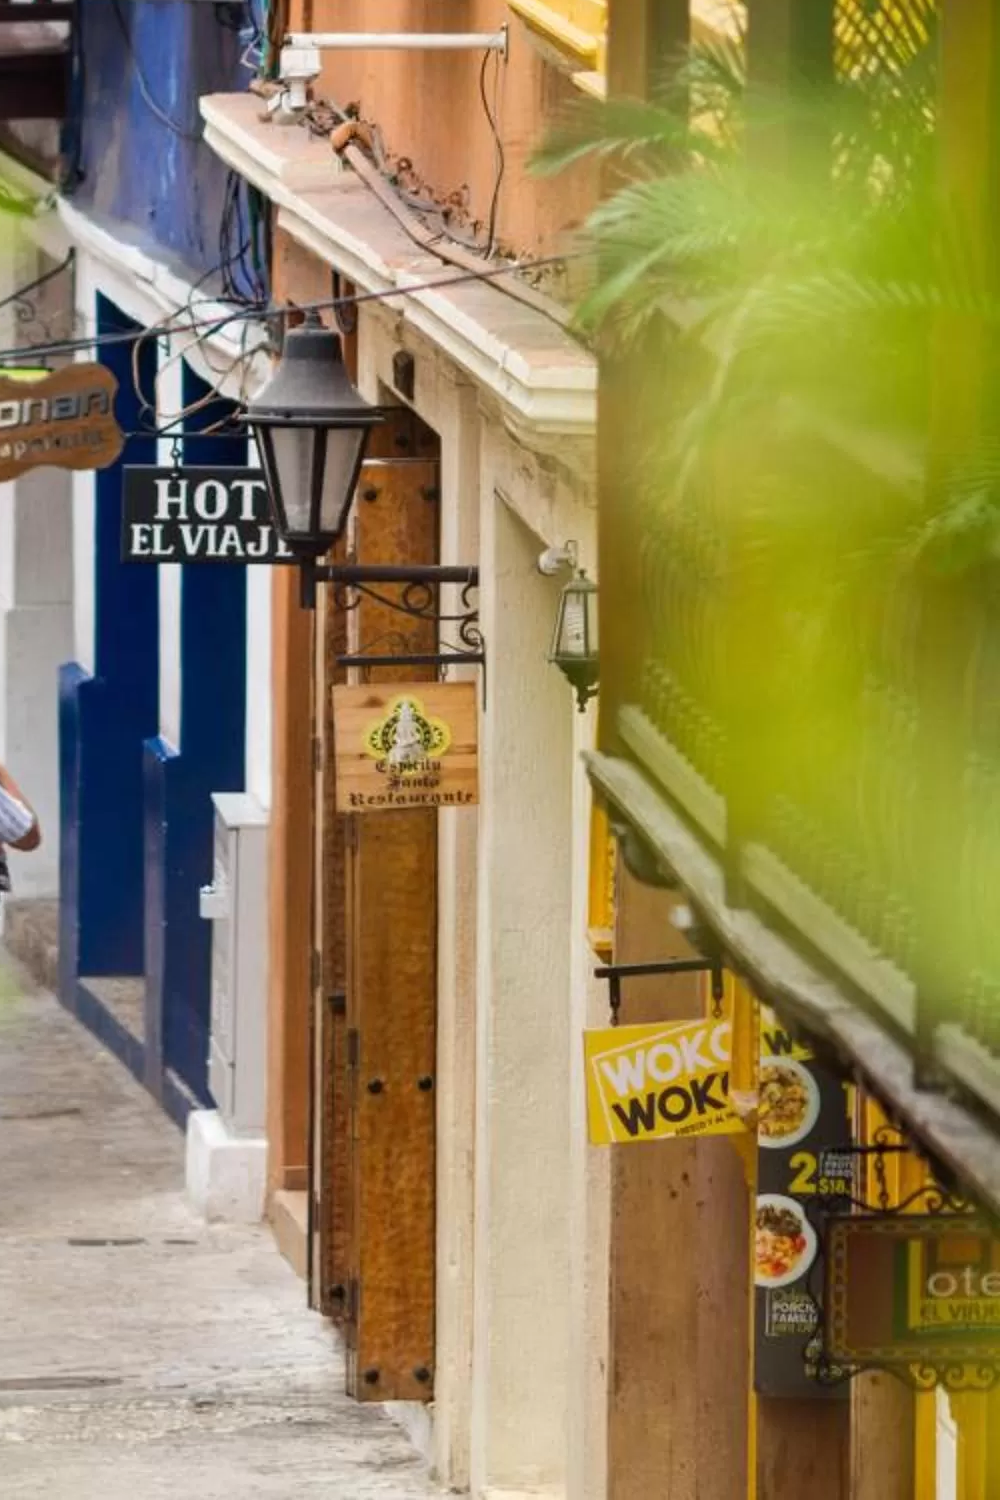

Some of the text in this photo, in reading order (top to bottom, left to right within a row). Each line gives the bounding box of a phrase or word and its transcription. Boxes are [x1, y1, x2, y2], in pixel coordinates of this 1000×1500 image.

[153, 478, 268, 521] HOT
[130, 523, 175, 556] EL
[611, 1071, 729, 1137] WOK
[788, 1151, 818, 1194] 2
